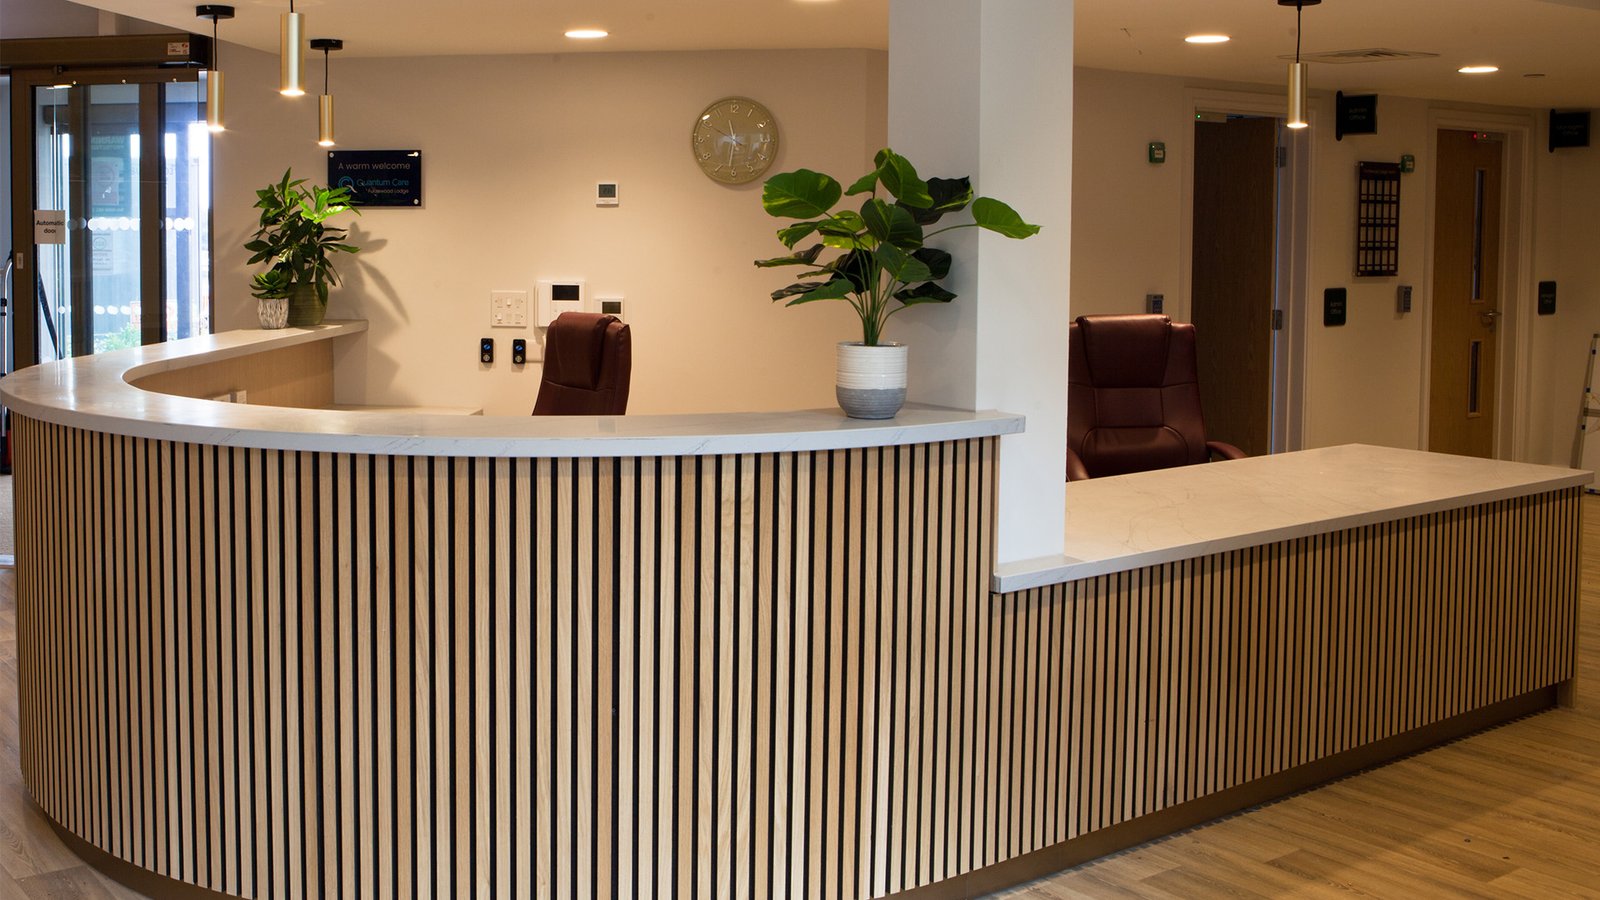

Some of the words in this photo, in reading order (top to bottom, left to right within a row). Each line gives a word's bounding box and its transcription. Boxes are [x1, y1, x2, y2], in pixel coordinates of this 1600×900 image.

[730, 104, 740, 114] 12
[338, 162, 344, 170] A
[372, 162, 411, 170] welcome
[357, 178, 391, 187] Quantum
[392, 178, 409, 186] Care
